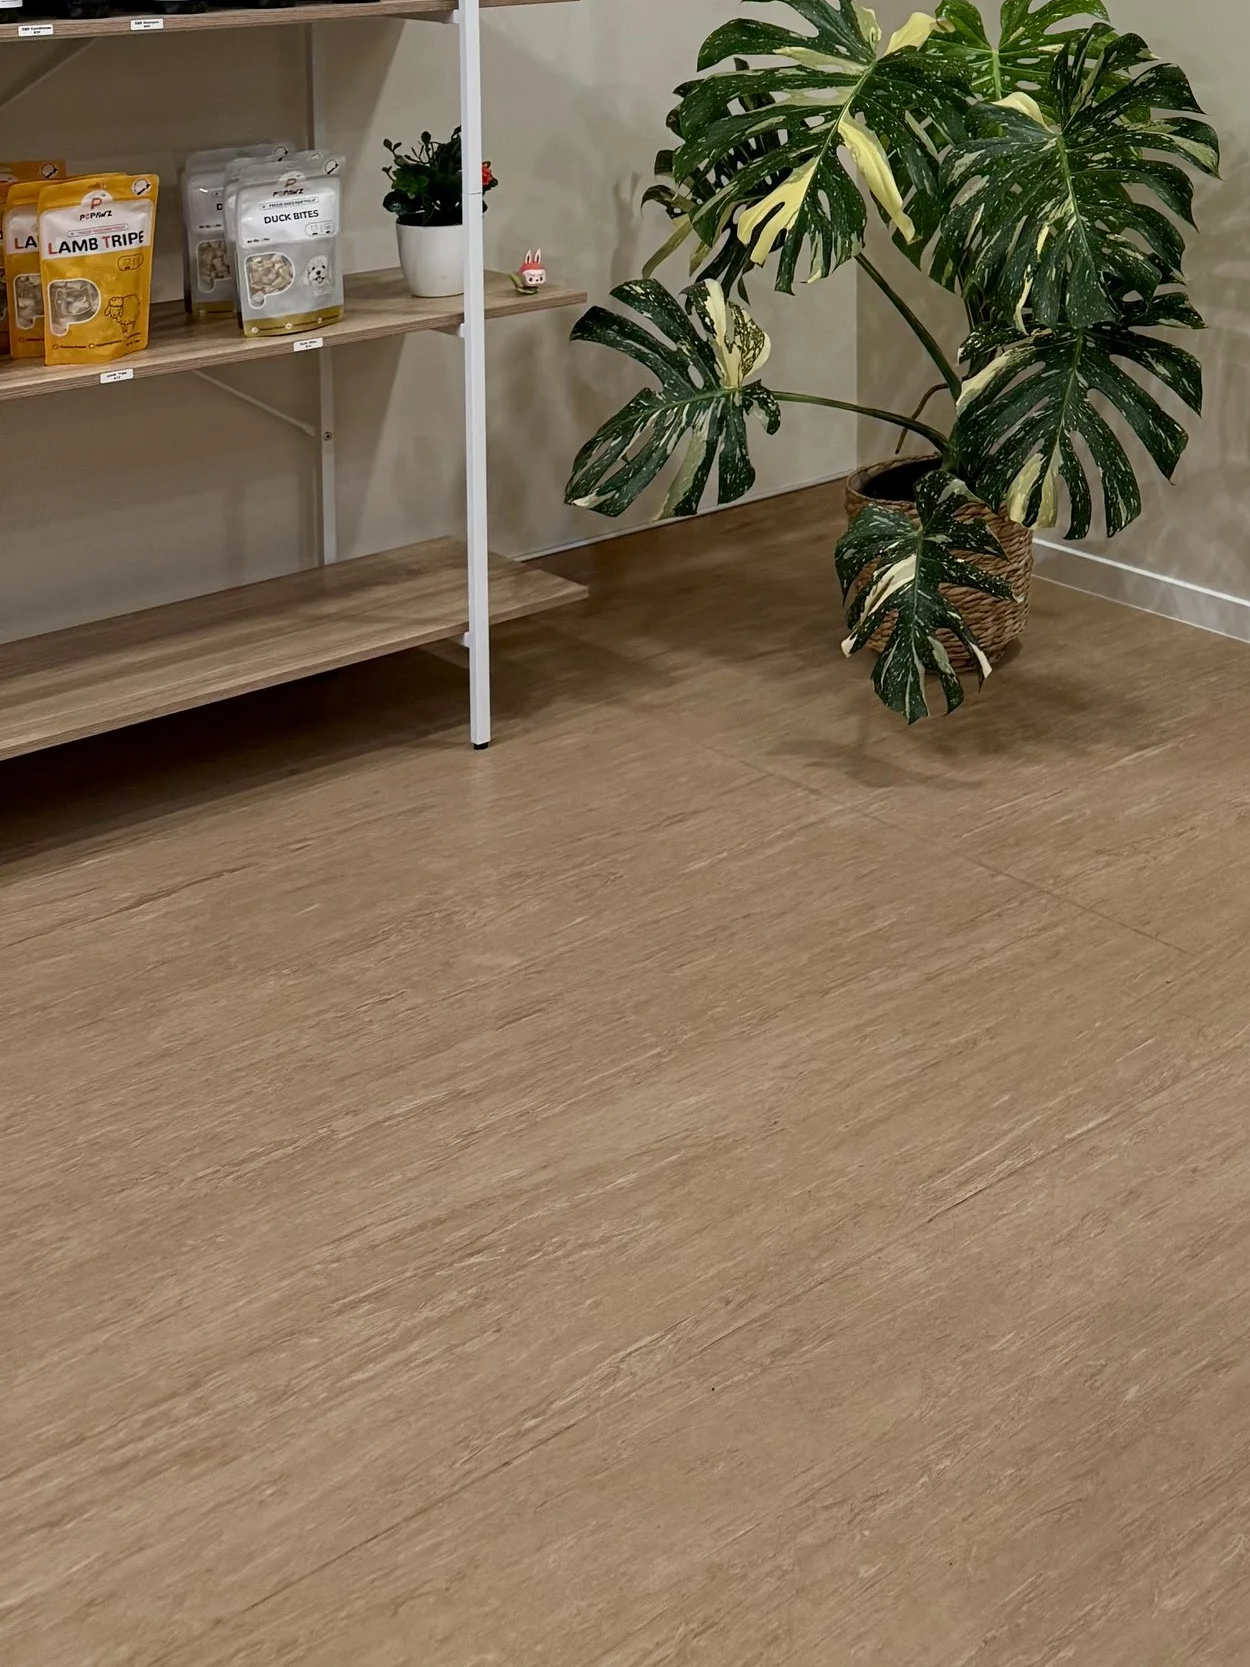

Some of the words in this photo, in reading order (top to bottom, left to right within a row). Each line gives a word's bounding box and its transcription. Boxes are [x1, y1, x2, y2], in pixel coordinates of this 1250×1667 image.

[264, 213, 291, 224] DUCK
[293, 209, 319, 220] BITES
[48, 238, 98, 255] LAMB
[102, 230, 144, 248] TRIPE
